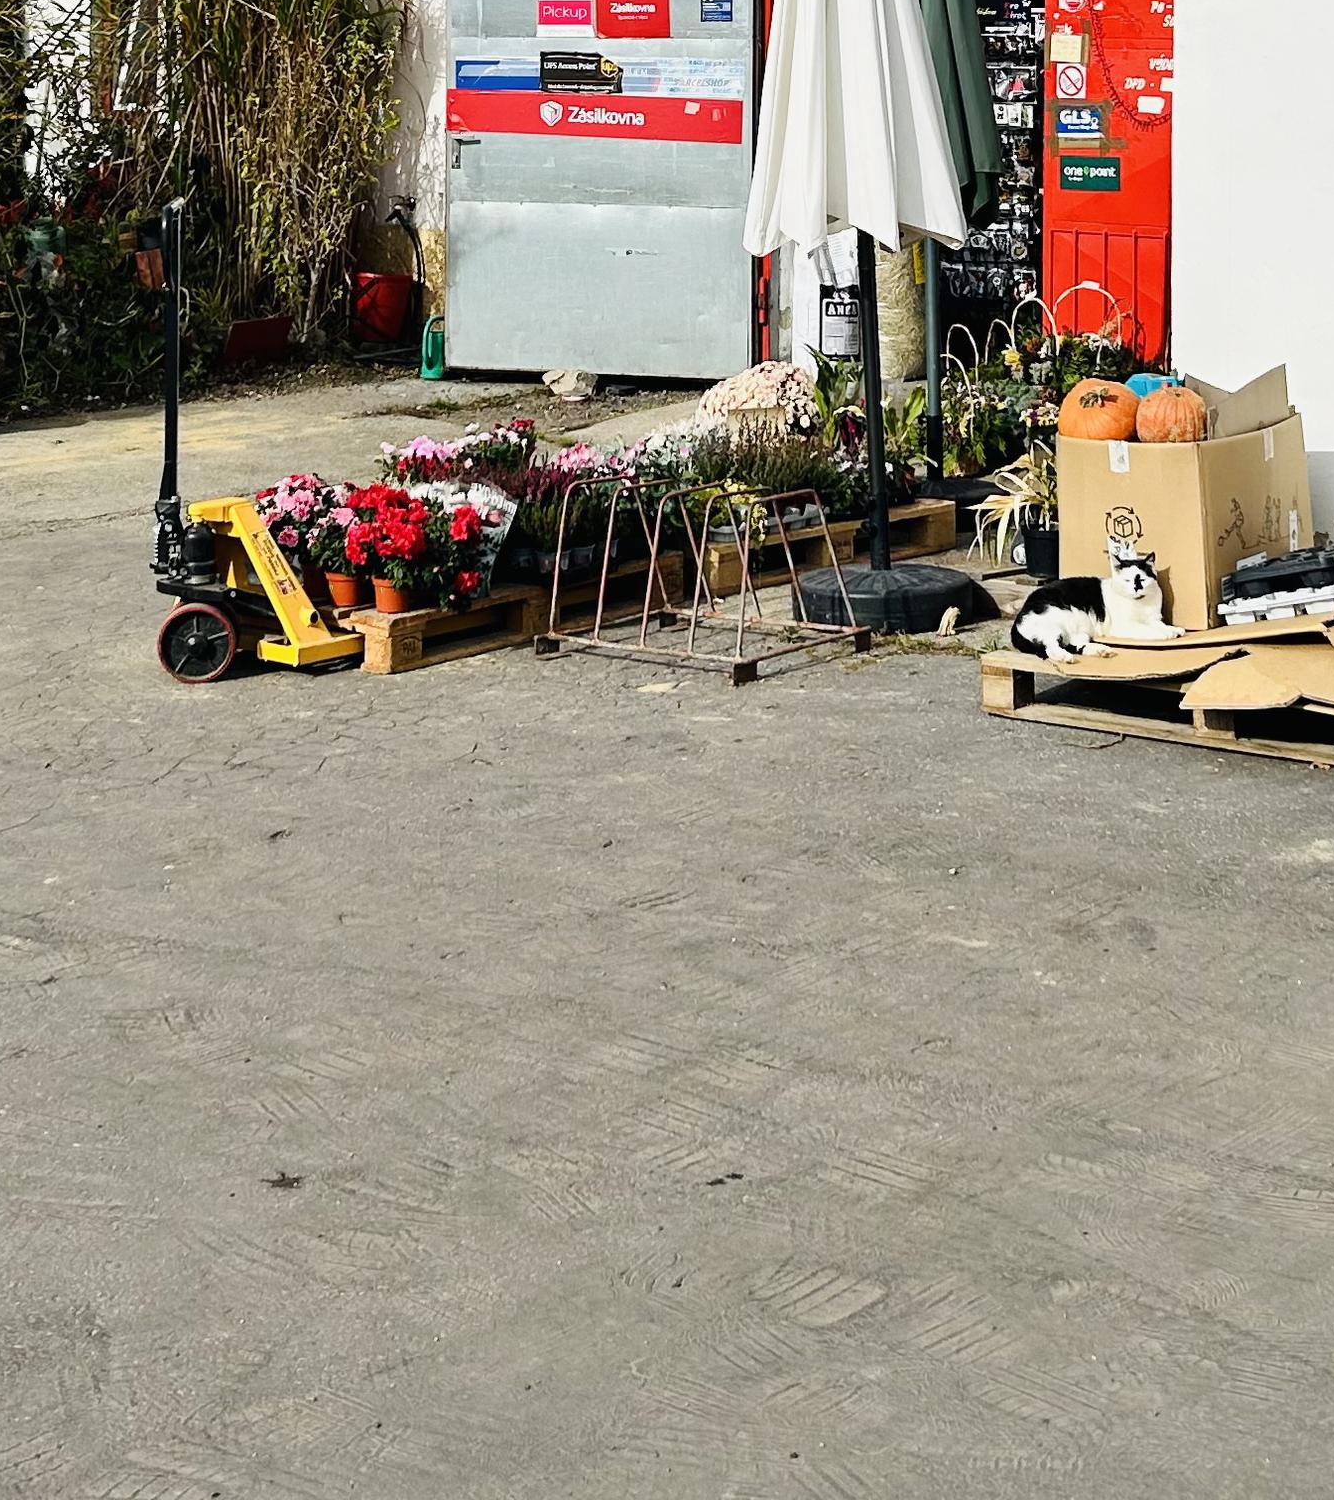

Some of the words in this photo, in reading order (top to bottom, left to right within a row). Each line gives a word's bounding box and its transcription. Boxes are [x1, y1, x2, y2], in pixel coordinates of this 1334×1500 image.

[542, 5, 587, 20] Pickup
[567, 106, 645, 126] Zásilkovna
[1059, 109, 1091, 124] GLS
